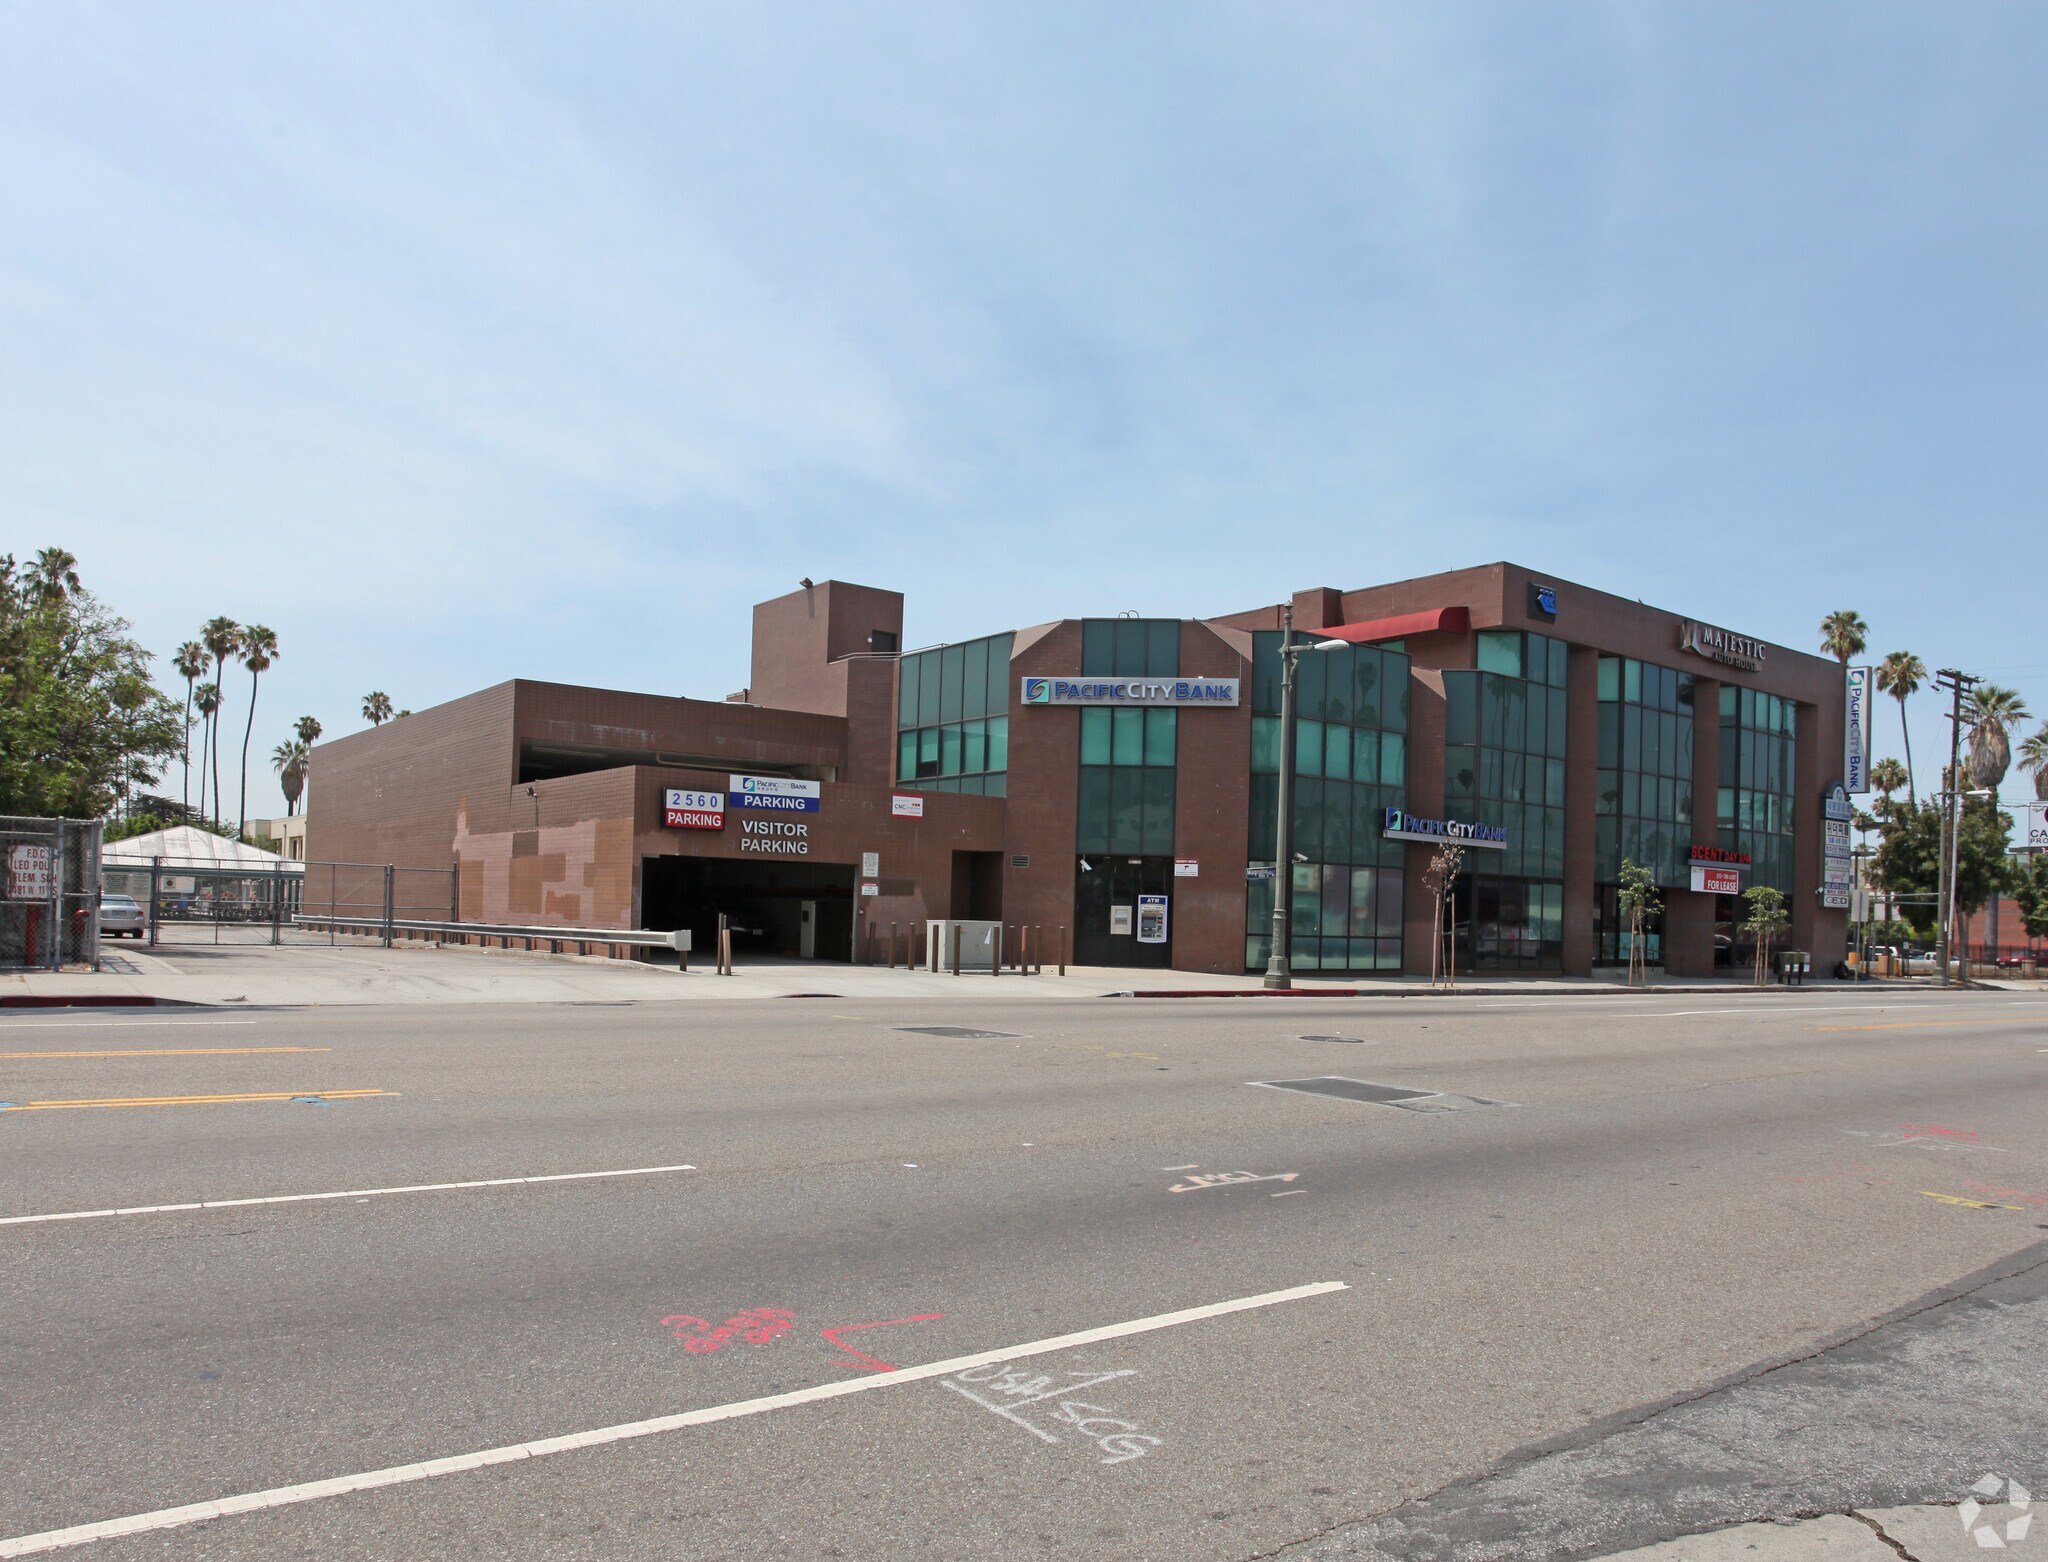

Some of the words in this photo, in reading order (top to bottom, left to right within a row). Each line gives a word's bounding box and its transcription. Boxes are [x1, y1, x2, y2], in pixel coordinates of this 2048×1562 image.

[1703, 627, 1766, 660] MAJESTIC
[1714, 652, 1734, 664] AUTO
[672, 793, 718, 808] 2560
[744, 795, 806, 810] PARKING
[668, 812, 722, 827] PARKING
[741, 820, 808, 837] VISITOR
[740, 838, 808, 854] PARKING
[1691, 844, 1725, 861] SCENT
[14, 860, 30, 870] LEO
[1707, 880, 1720, 890] FOR
[1720, 881, 1736, 892] LEASE
